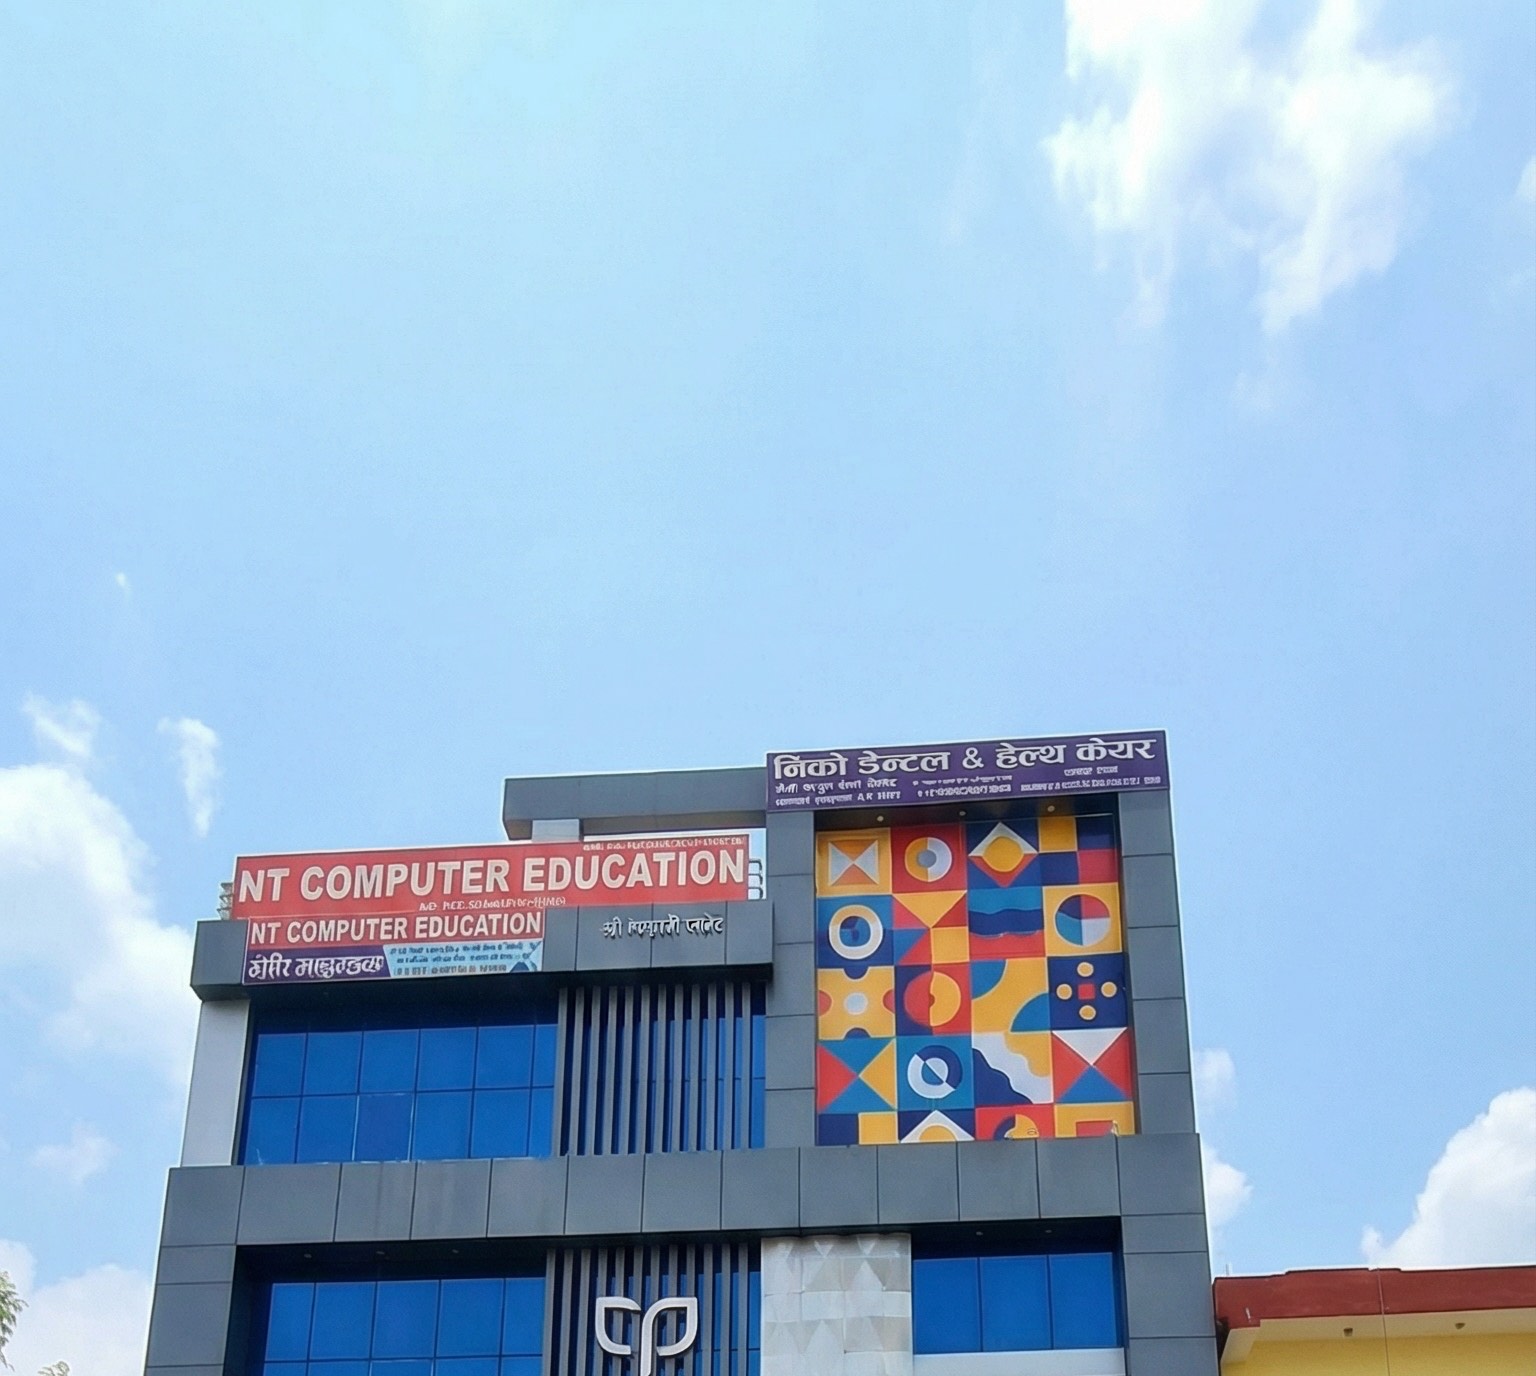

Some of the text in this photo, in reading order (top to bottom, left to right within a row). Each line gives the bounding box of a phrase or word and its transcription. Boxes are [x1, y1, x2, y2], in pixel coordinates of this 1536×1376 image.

[774, 737, 1157, 779] निको डेन्टल & हेल्थ केयर
[238, 849, 744, 902] NT COMPUTER EDUCATION
[251, 912, 541, 944] NT COMPUTER EDUCATION
